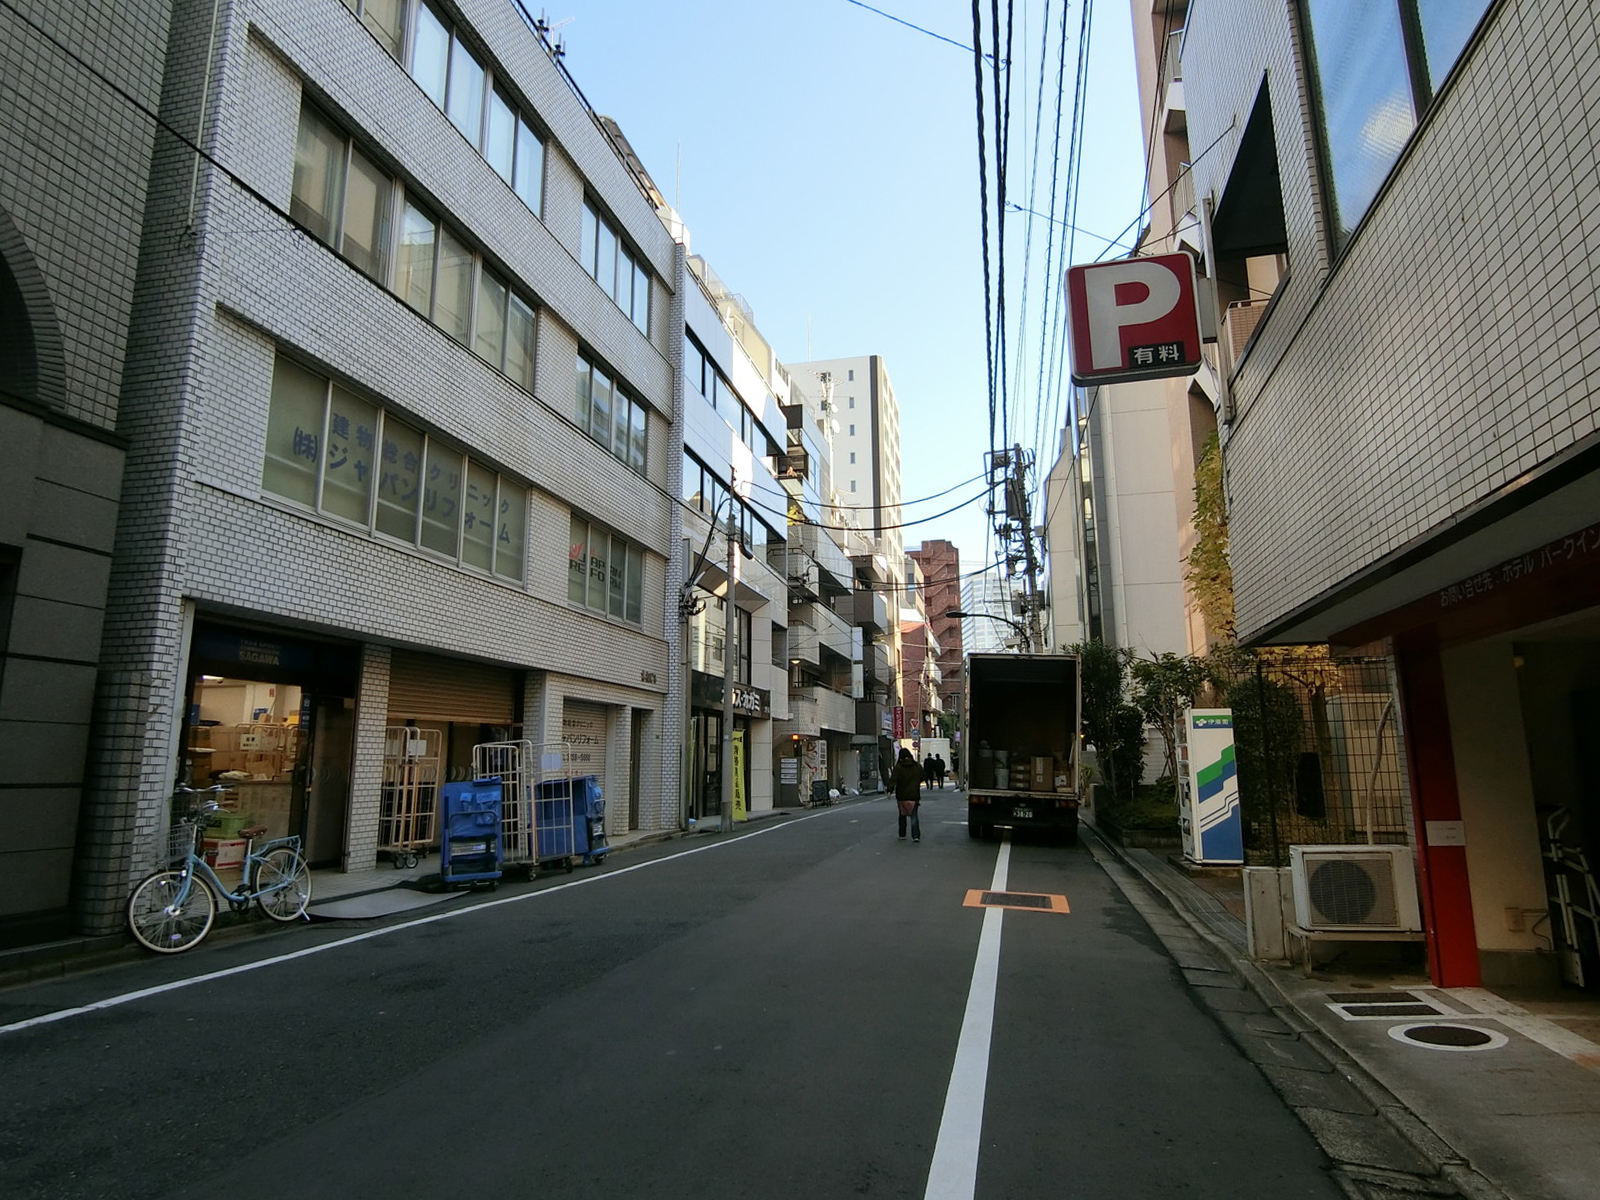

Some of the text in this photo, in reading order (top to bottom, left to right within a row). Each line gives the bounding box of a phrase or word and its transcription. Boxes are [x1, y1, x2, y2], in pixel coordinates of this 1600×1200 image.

[1084, 261, 1181, 370] P
[1133, 344, 1179, 365] 有料
[332, 412, 508, 514] 建物総合クリニック
[1502, 555, 1534, 582] ホテル
[238, 650, 280, 666] SAGAWA
